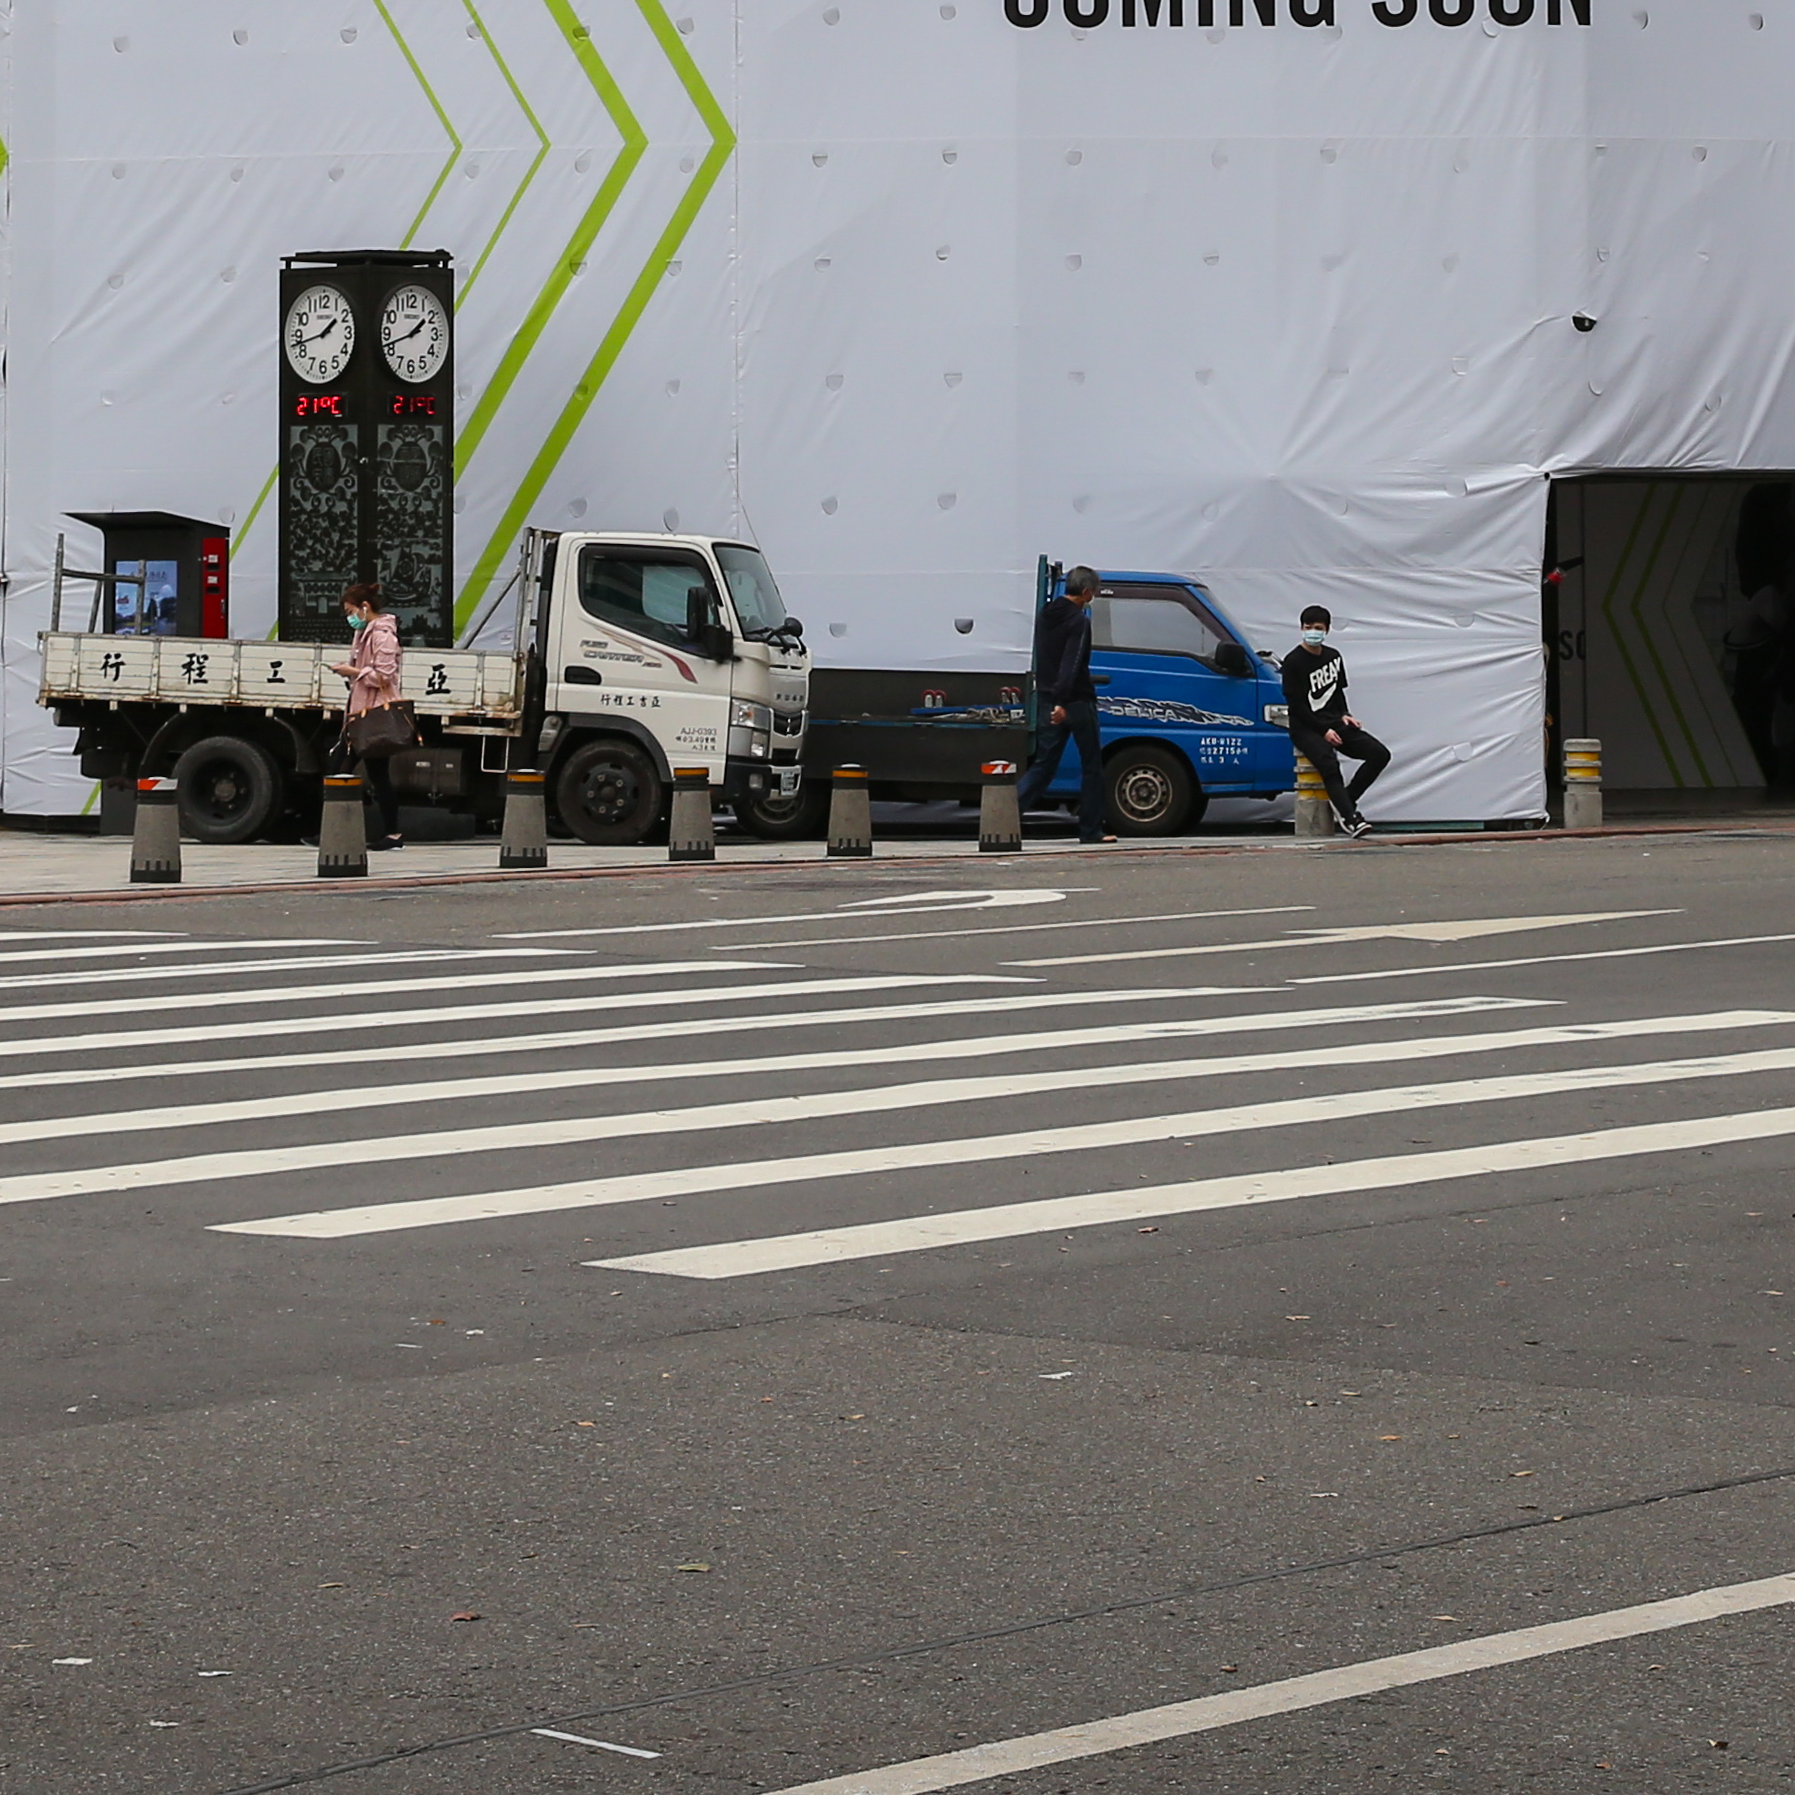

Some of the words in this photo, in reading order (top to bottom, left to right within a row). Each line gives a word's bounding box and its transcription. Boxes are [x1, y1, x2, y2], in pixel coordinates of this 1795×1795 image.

[319, 295, 330, 309] 12
[406, 294, 417, 308] 12
[298, 312, 309, 326] 10
[341, 309, 350, 323] 2
[386, 310, 397, 324] 10
[428, 310, 436, 324] 2
[295, 329, 303, 343] 9
[344, 326, 353, 340] 3
[383, 326, 391, 341] 9
[430, 327, 439, 342] 3
[340, 342, 349, 356] 4
[427, 344, 435, 357] 4
[308, 357, 317, 371] 7
[319, 360, 328, 374] 6
[331, 356, 340, 370] 5
[396, 356, 404, 369] 7
[406, 359, 415, 373] 6
[419, 356, 427, 370] 5
